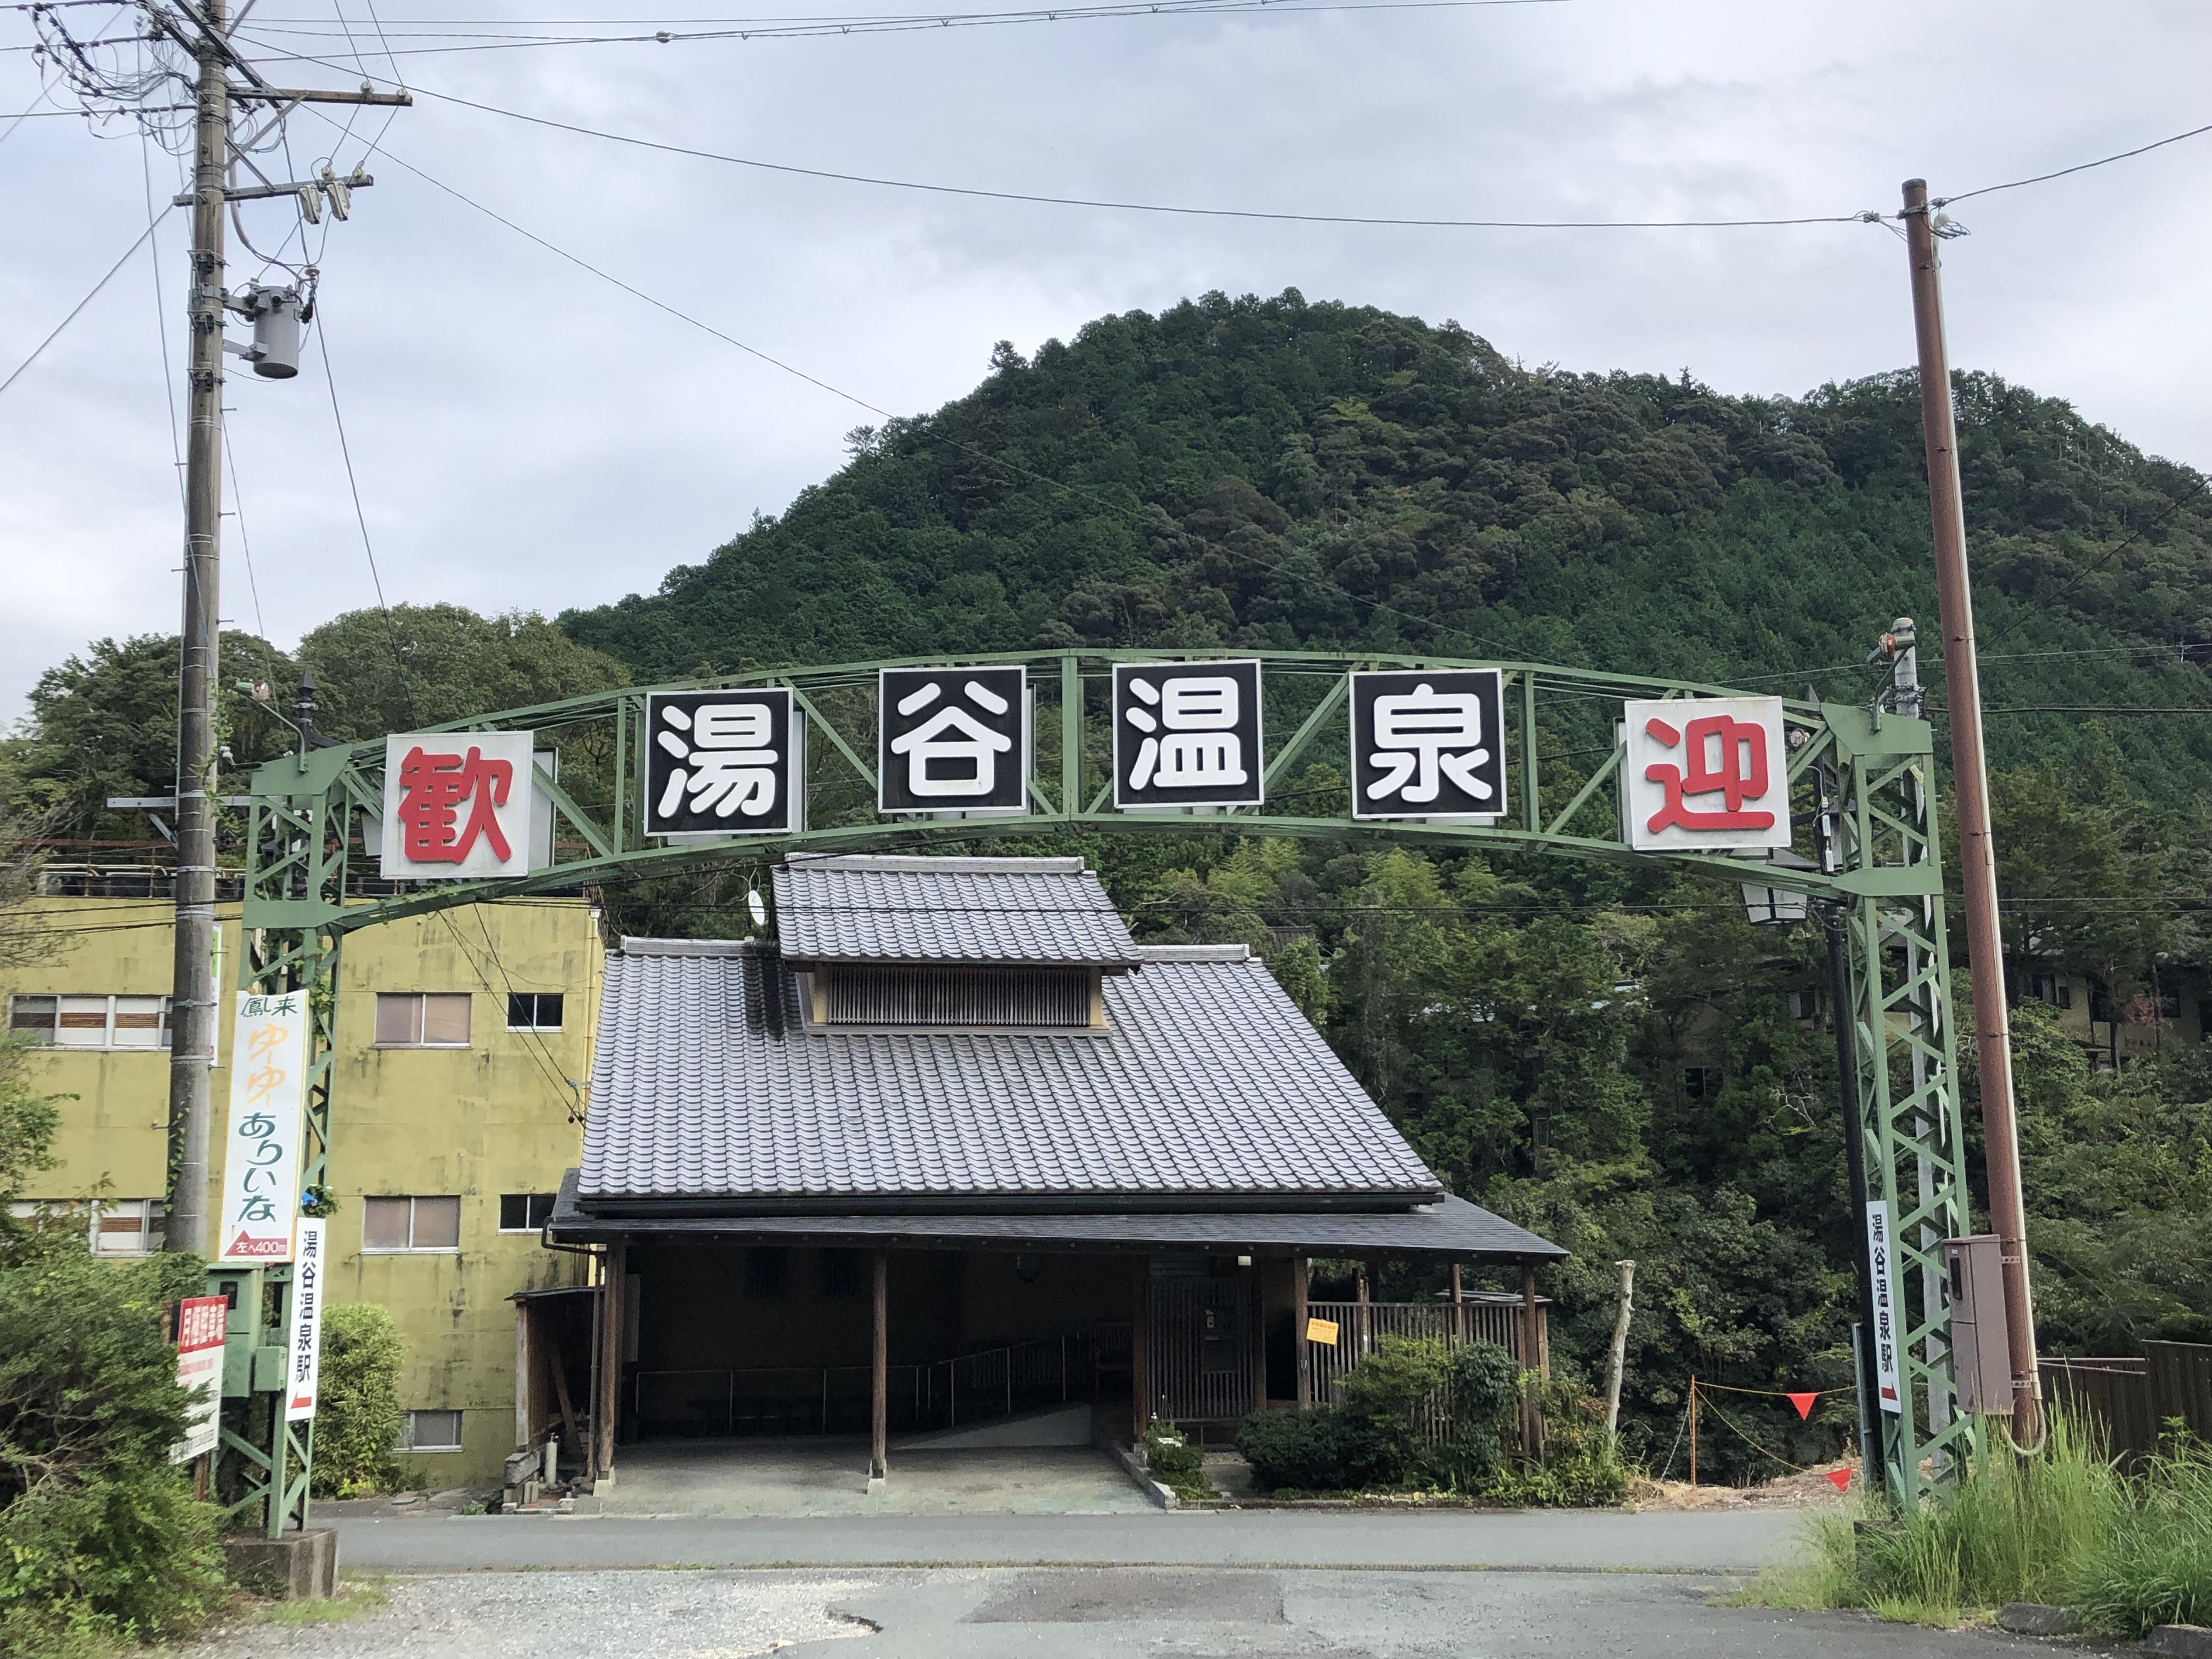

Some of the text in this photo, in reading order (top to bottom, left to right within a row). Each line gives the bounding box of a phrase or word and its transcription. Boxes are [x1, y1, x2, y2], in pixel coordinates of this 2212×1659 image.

[398, 745, 514, 865] 歓
[657, 677, 1492, 818] 湯谷温泉
[1646, 714, 1775, 832] 迎
[295, 1231, 317, 1383] 湯谷温泉駅
[1872, 1214, 1893, 1373] 湯谷温泉駅
